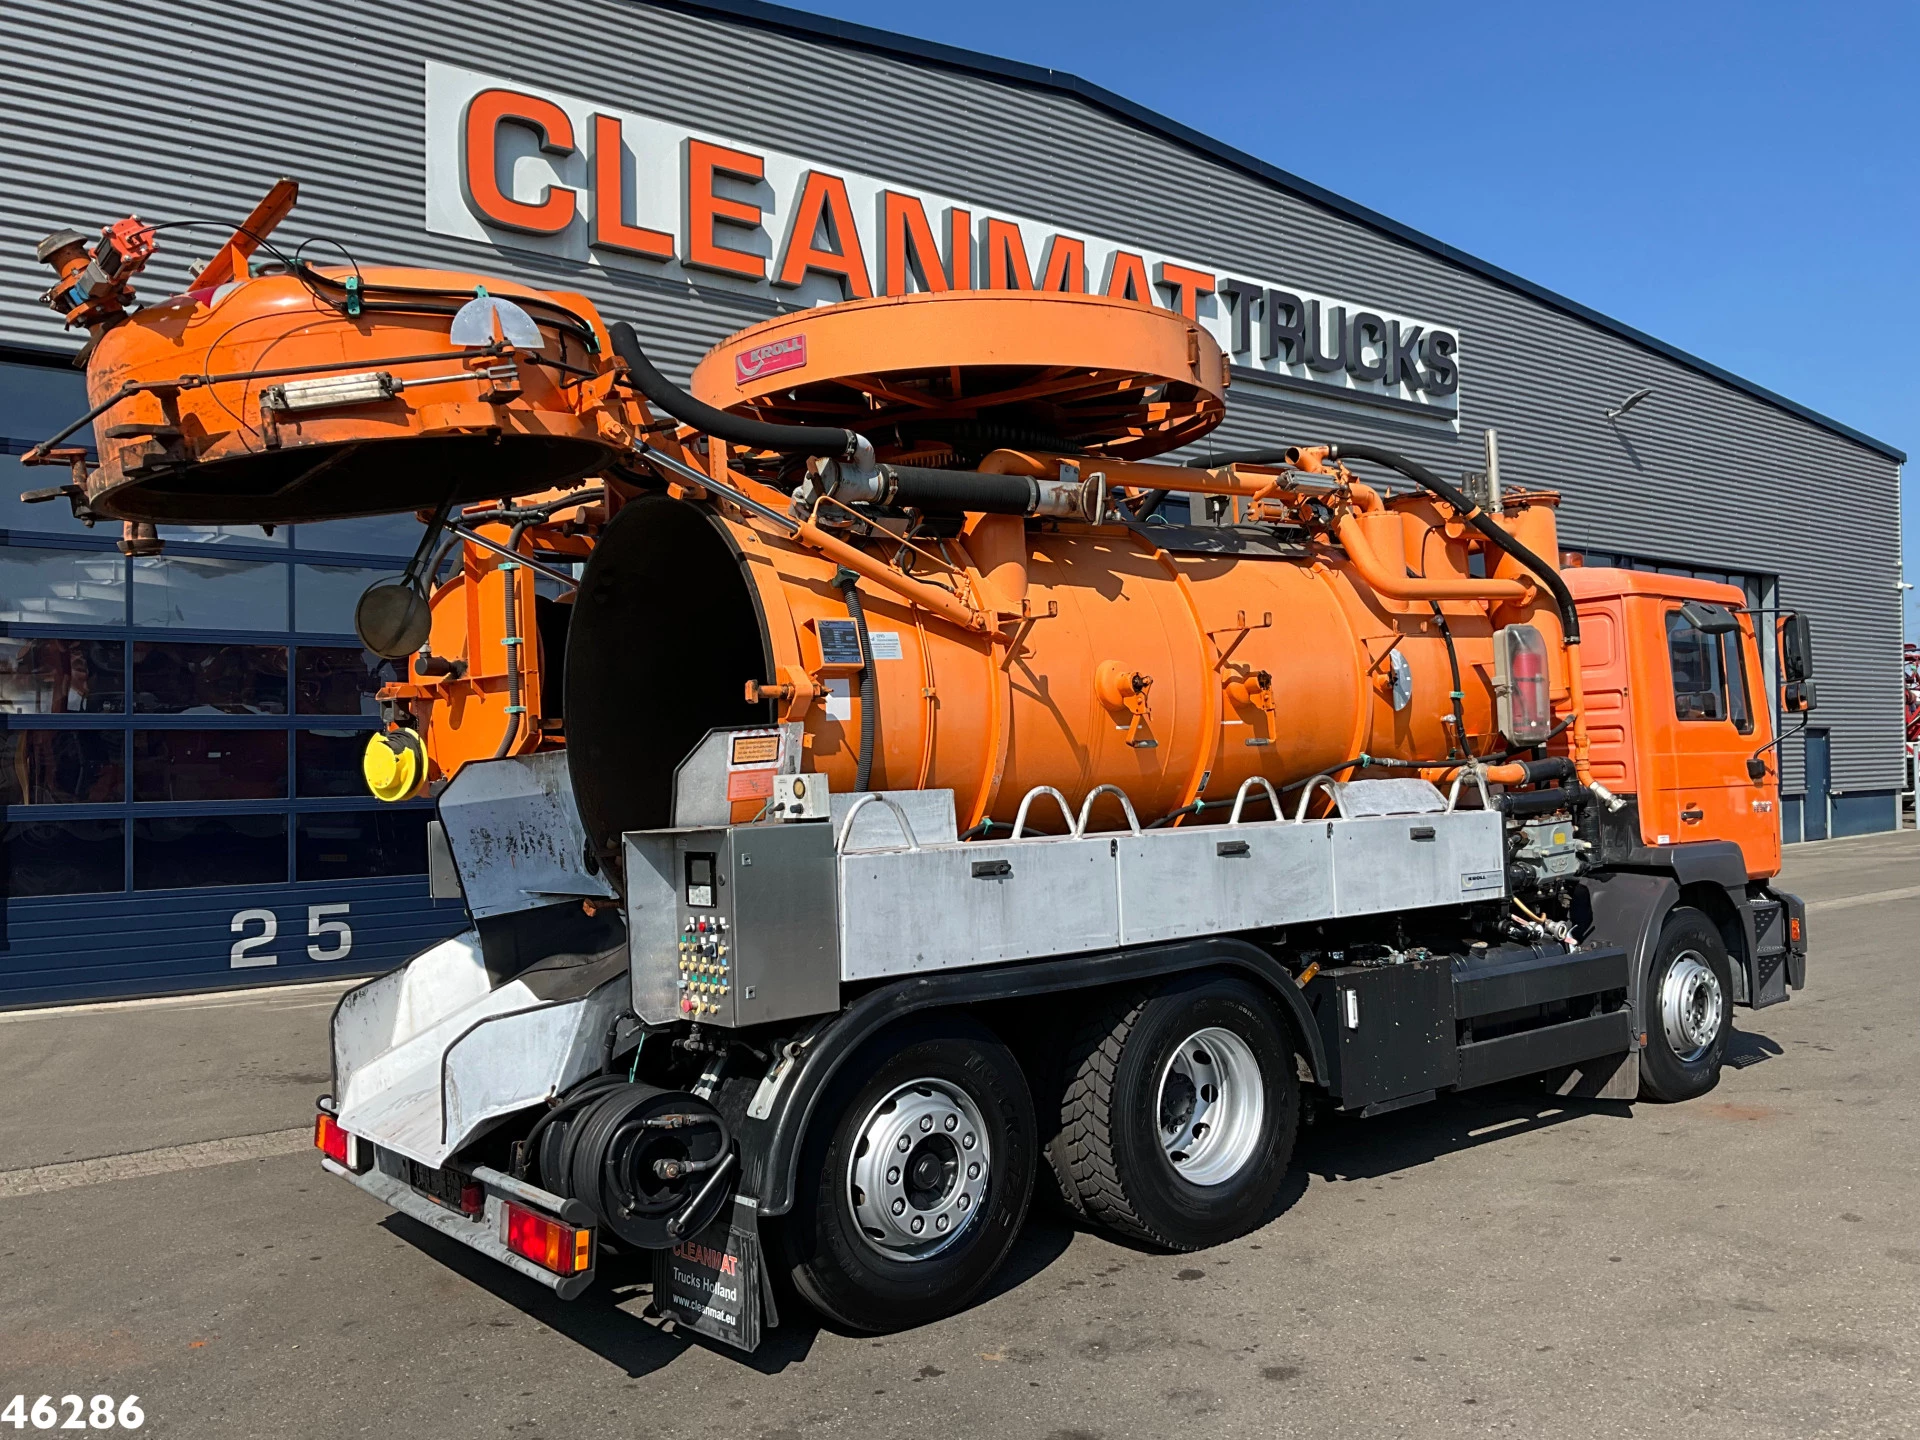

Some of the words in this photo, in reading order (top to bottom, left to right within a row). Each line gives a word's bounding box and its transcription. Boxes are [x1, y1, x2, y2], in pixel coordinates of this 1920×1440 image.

[750, 338, 802, 363] KROLL
[1219, 277, 1459, 396] TRUCKS
[672, 1241, 738, 1276] CLEANMAT
[673, 1267, 701, 1289] Trucks
[703, 1278, 737, 1301] Holland
[672, 1293, 736, 1325] www.cleanmat.eu
